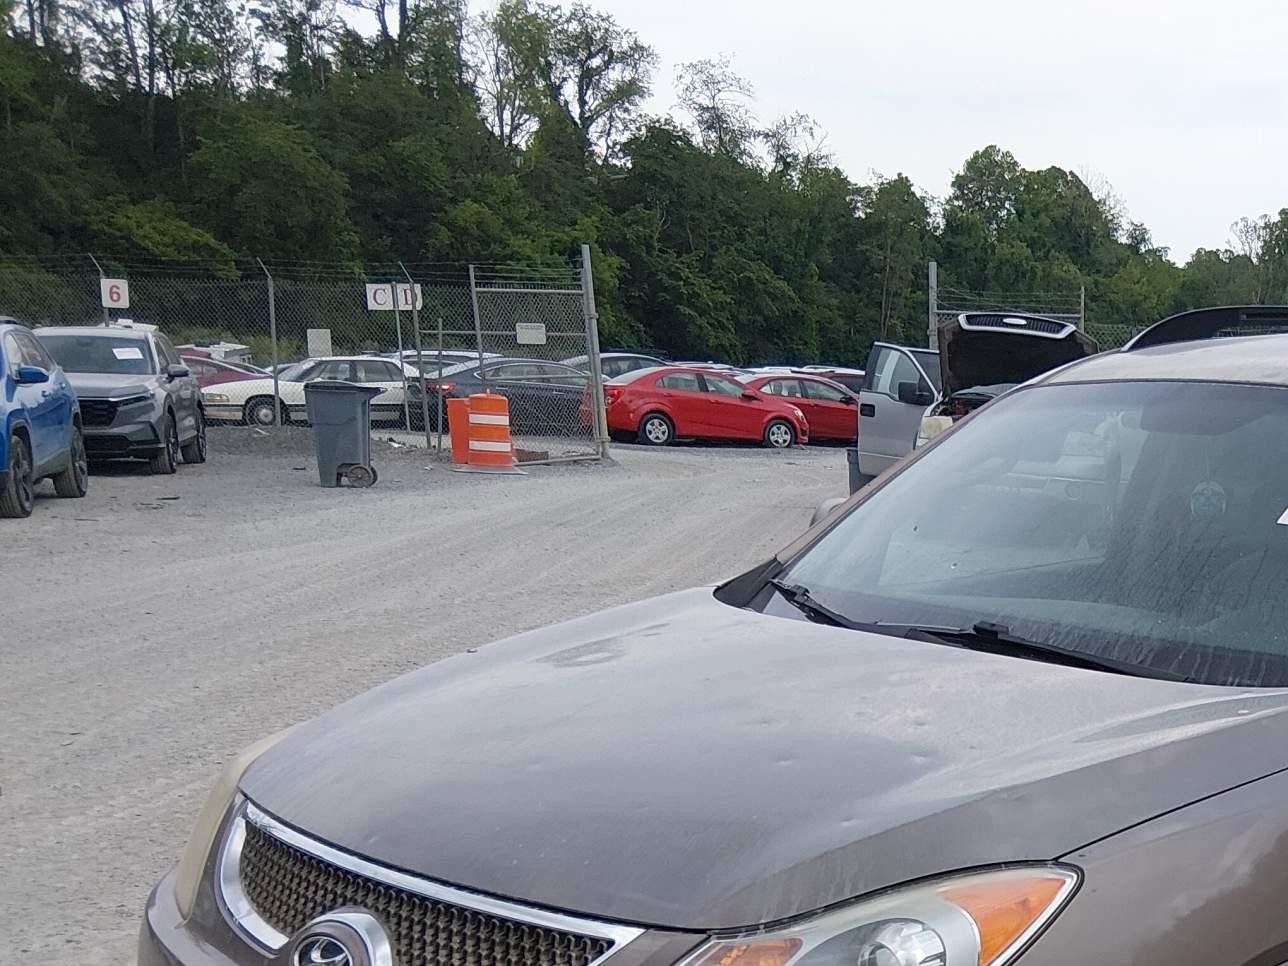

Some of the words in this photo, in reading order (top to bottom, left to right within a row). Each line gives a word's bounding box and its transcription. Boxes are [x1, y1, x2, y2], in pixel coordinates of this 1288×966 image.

[109, 284, 121, 303] 6
[373, 288, 387, 306] C
[403, 288, 418, 306] D
